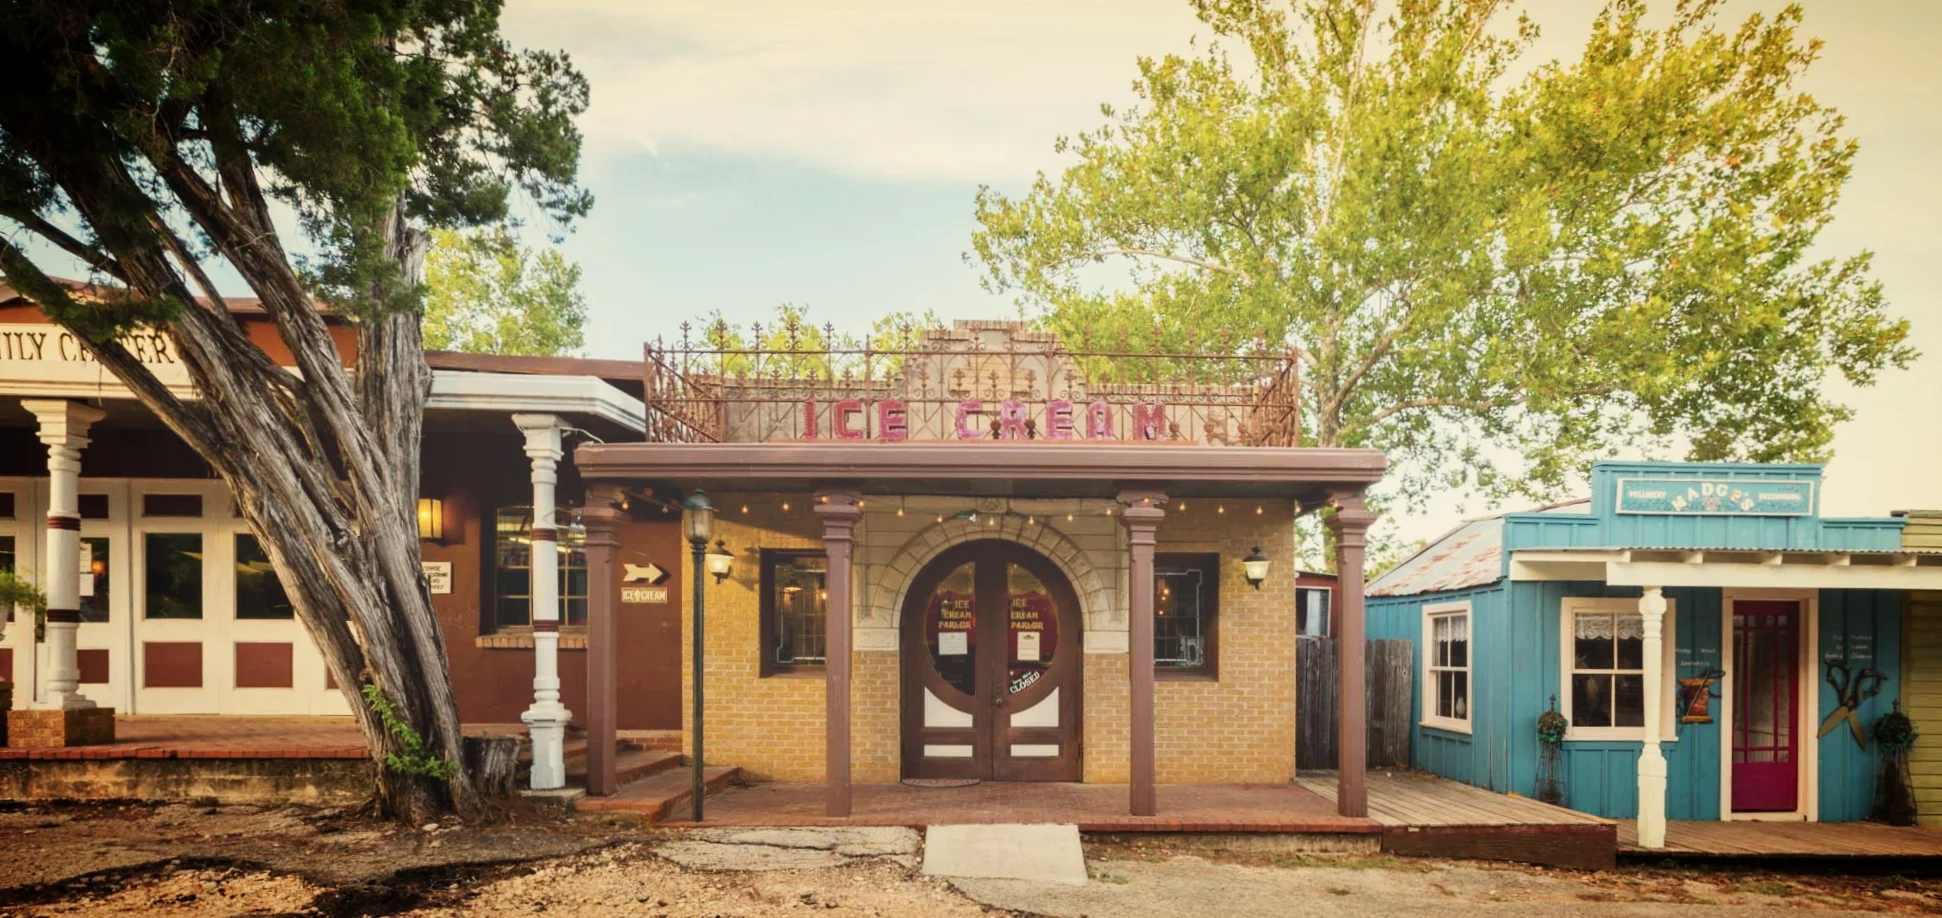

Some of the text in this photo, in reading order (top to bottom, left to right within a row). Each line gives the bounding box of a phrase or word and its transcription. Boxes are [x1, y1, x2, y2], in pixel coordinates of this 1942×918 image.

[0, 332, 47, 361] ILY
[804, 401, 1166, 440] ICE CREAM
[623, 590, 666, 601] ICE CREAM
[955, 600, 970, 609] ICE
[1012, 599, 1028, 608] ICE
[943, 611, 972, 619] CREAM
[1010, 611, 1039, 620] CREAM
[938, 621, 972, 631] PARLOR
[1010, 621, 1044, 631] PARLOR
[1009, 671, 1041, 694] CLOSED
